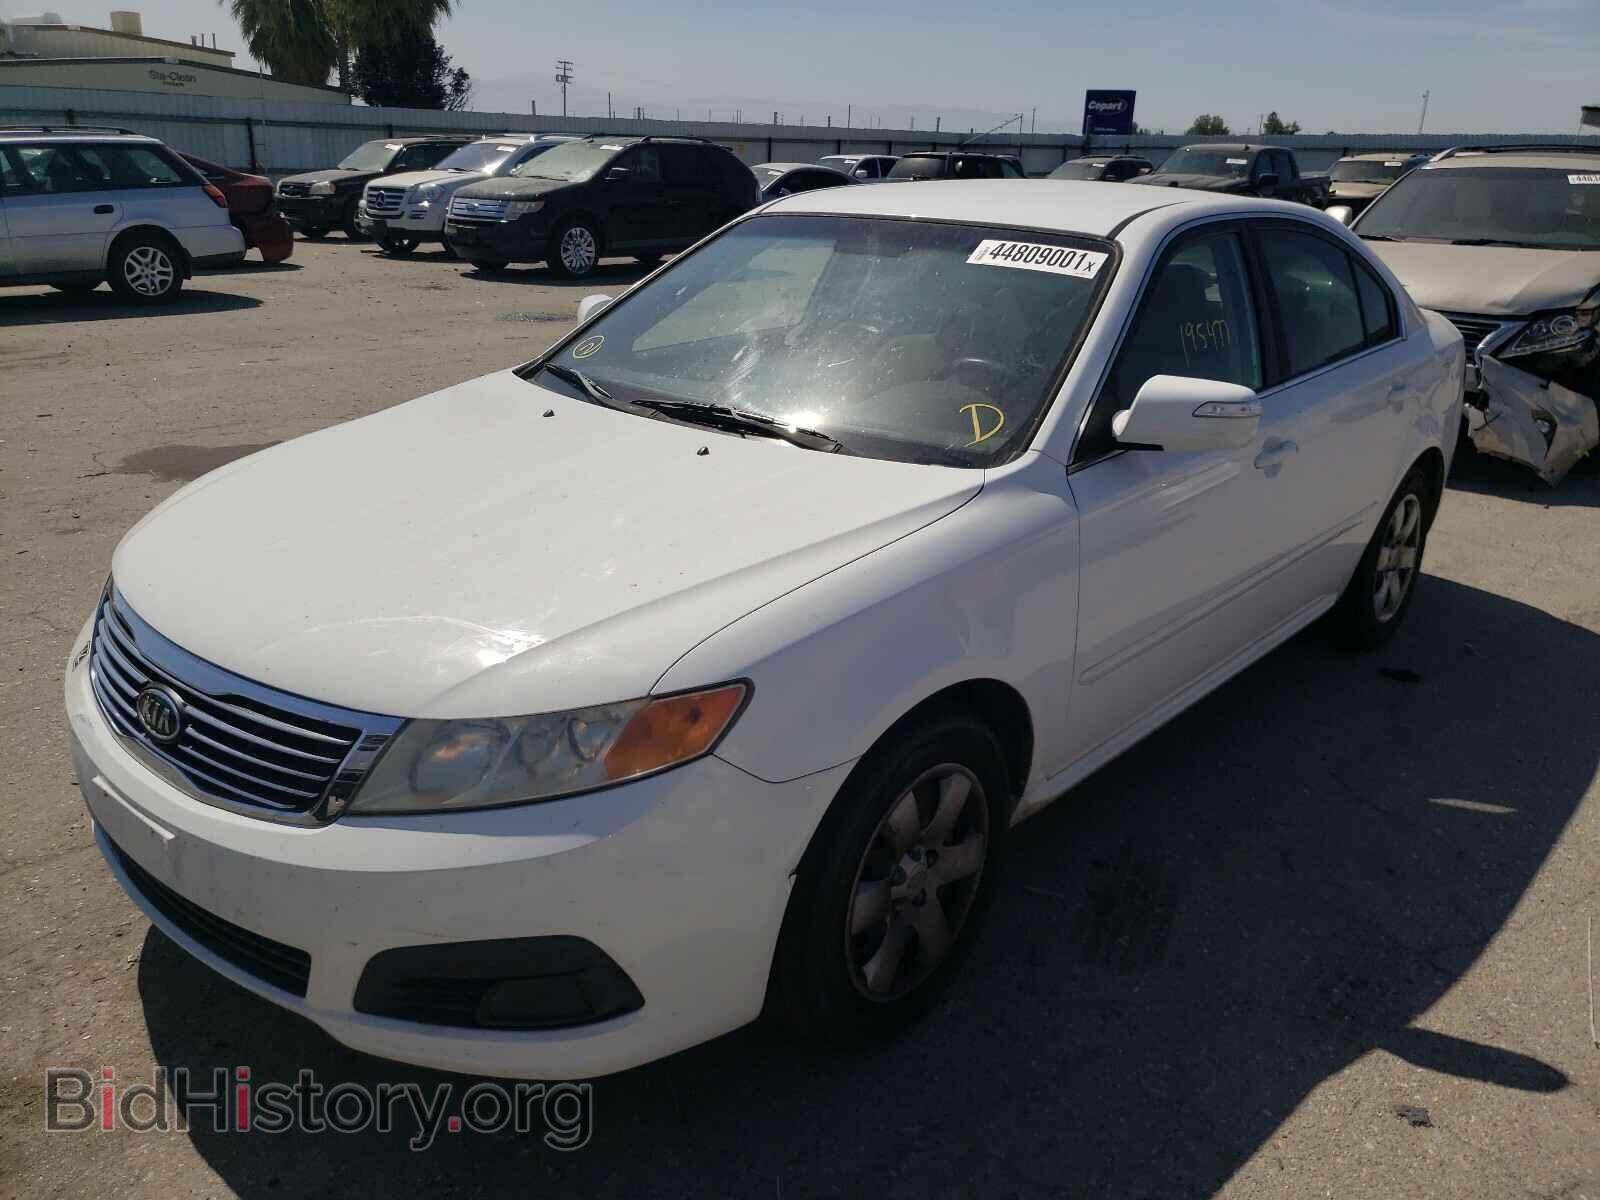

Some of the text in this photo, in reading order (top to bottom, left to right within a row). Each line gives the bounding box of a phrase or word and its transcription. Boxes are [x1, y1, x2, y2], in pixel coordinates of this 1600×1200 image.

[989, 242, 1089, 270] 44809001
[959, 403, 1005, 447] D
[142, 695, 170, 734] KIA
